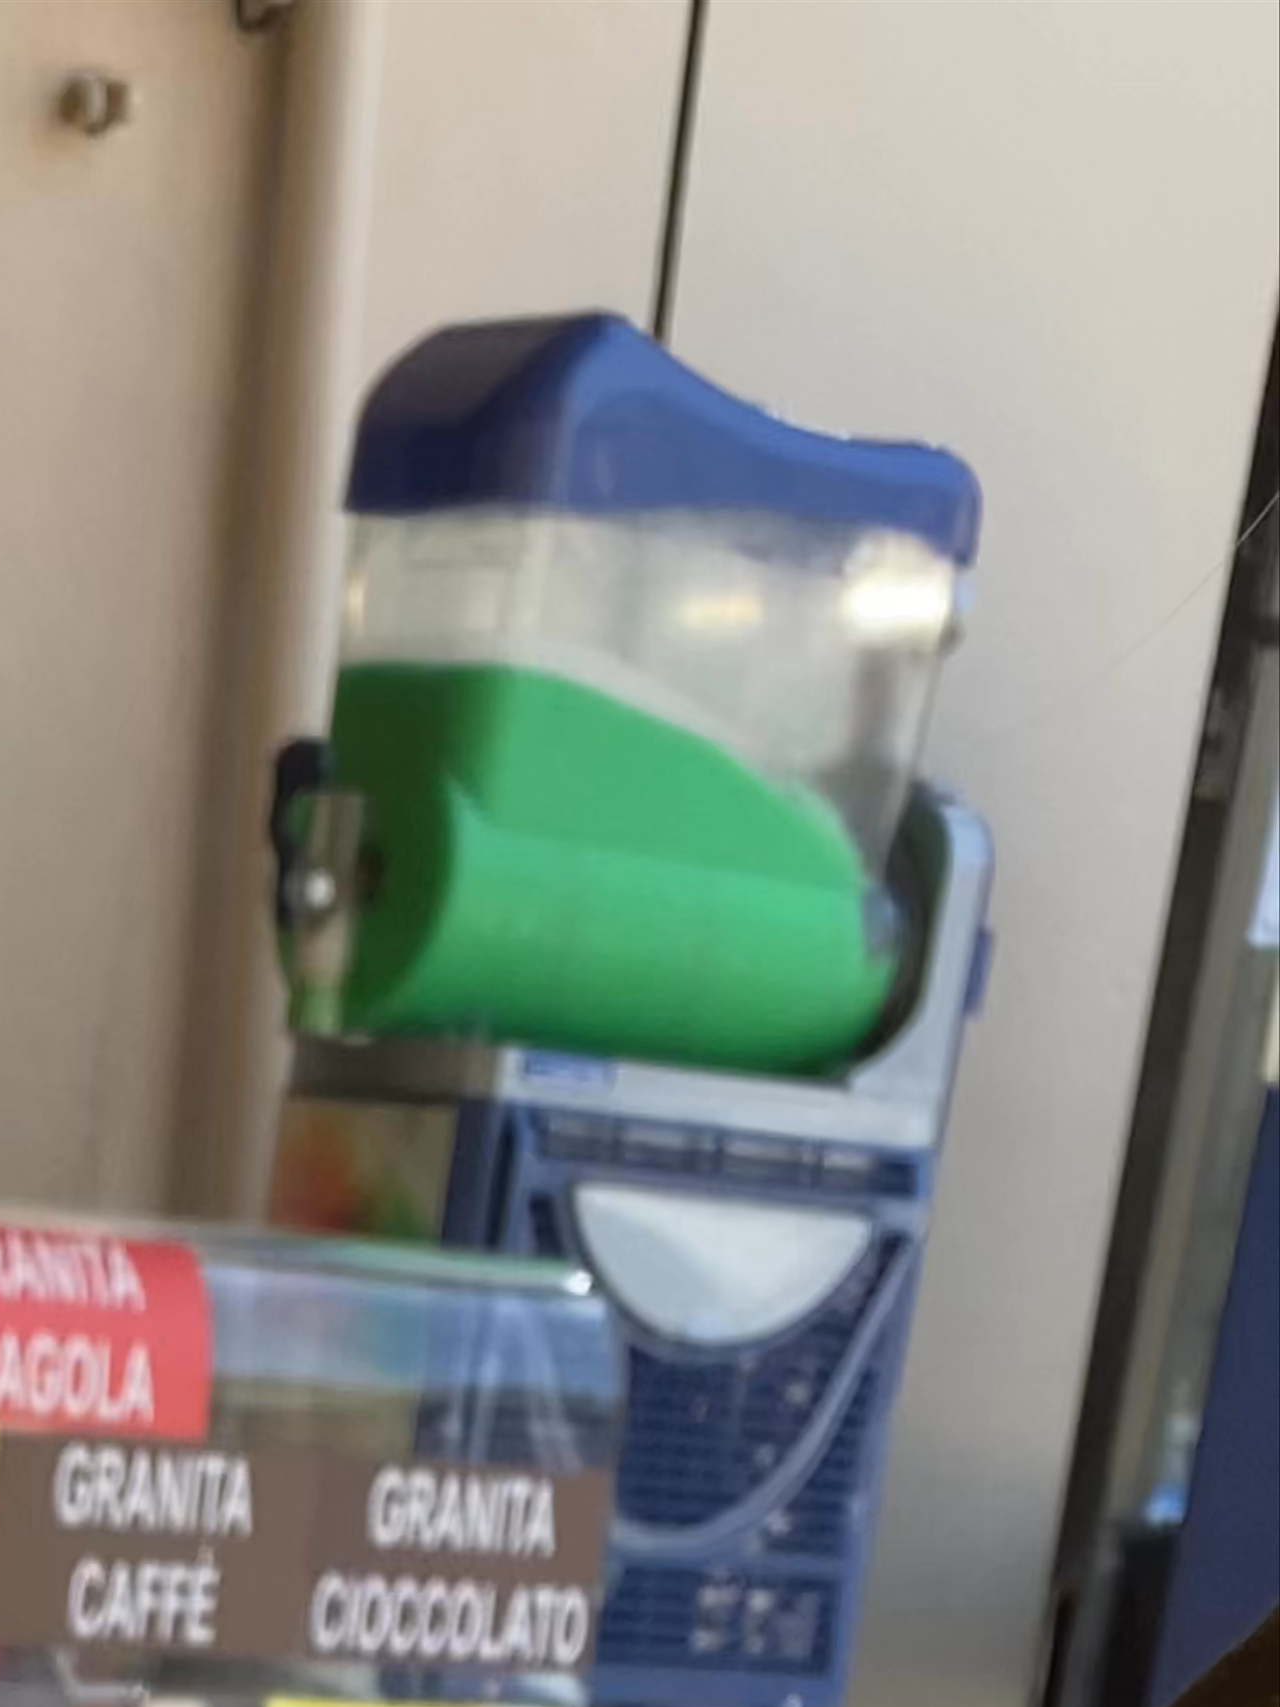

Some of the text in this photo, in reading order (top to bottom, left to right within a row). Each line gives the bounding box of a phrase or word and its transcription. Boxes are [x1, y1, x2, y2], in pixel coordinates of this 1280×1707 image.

[54, 1442, 253, 1536] GRANITA
[367, 1467, 555, 1558] GRANITA
[310, 1570, 589, 1667] CIOCCOLATO
